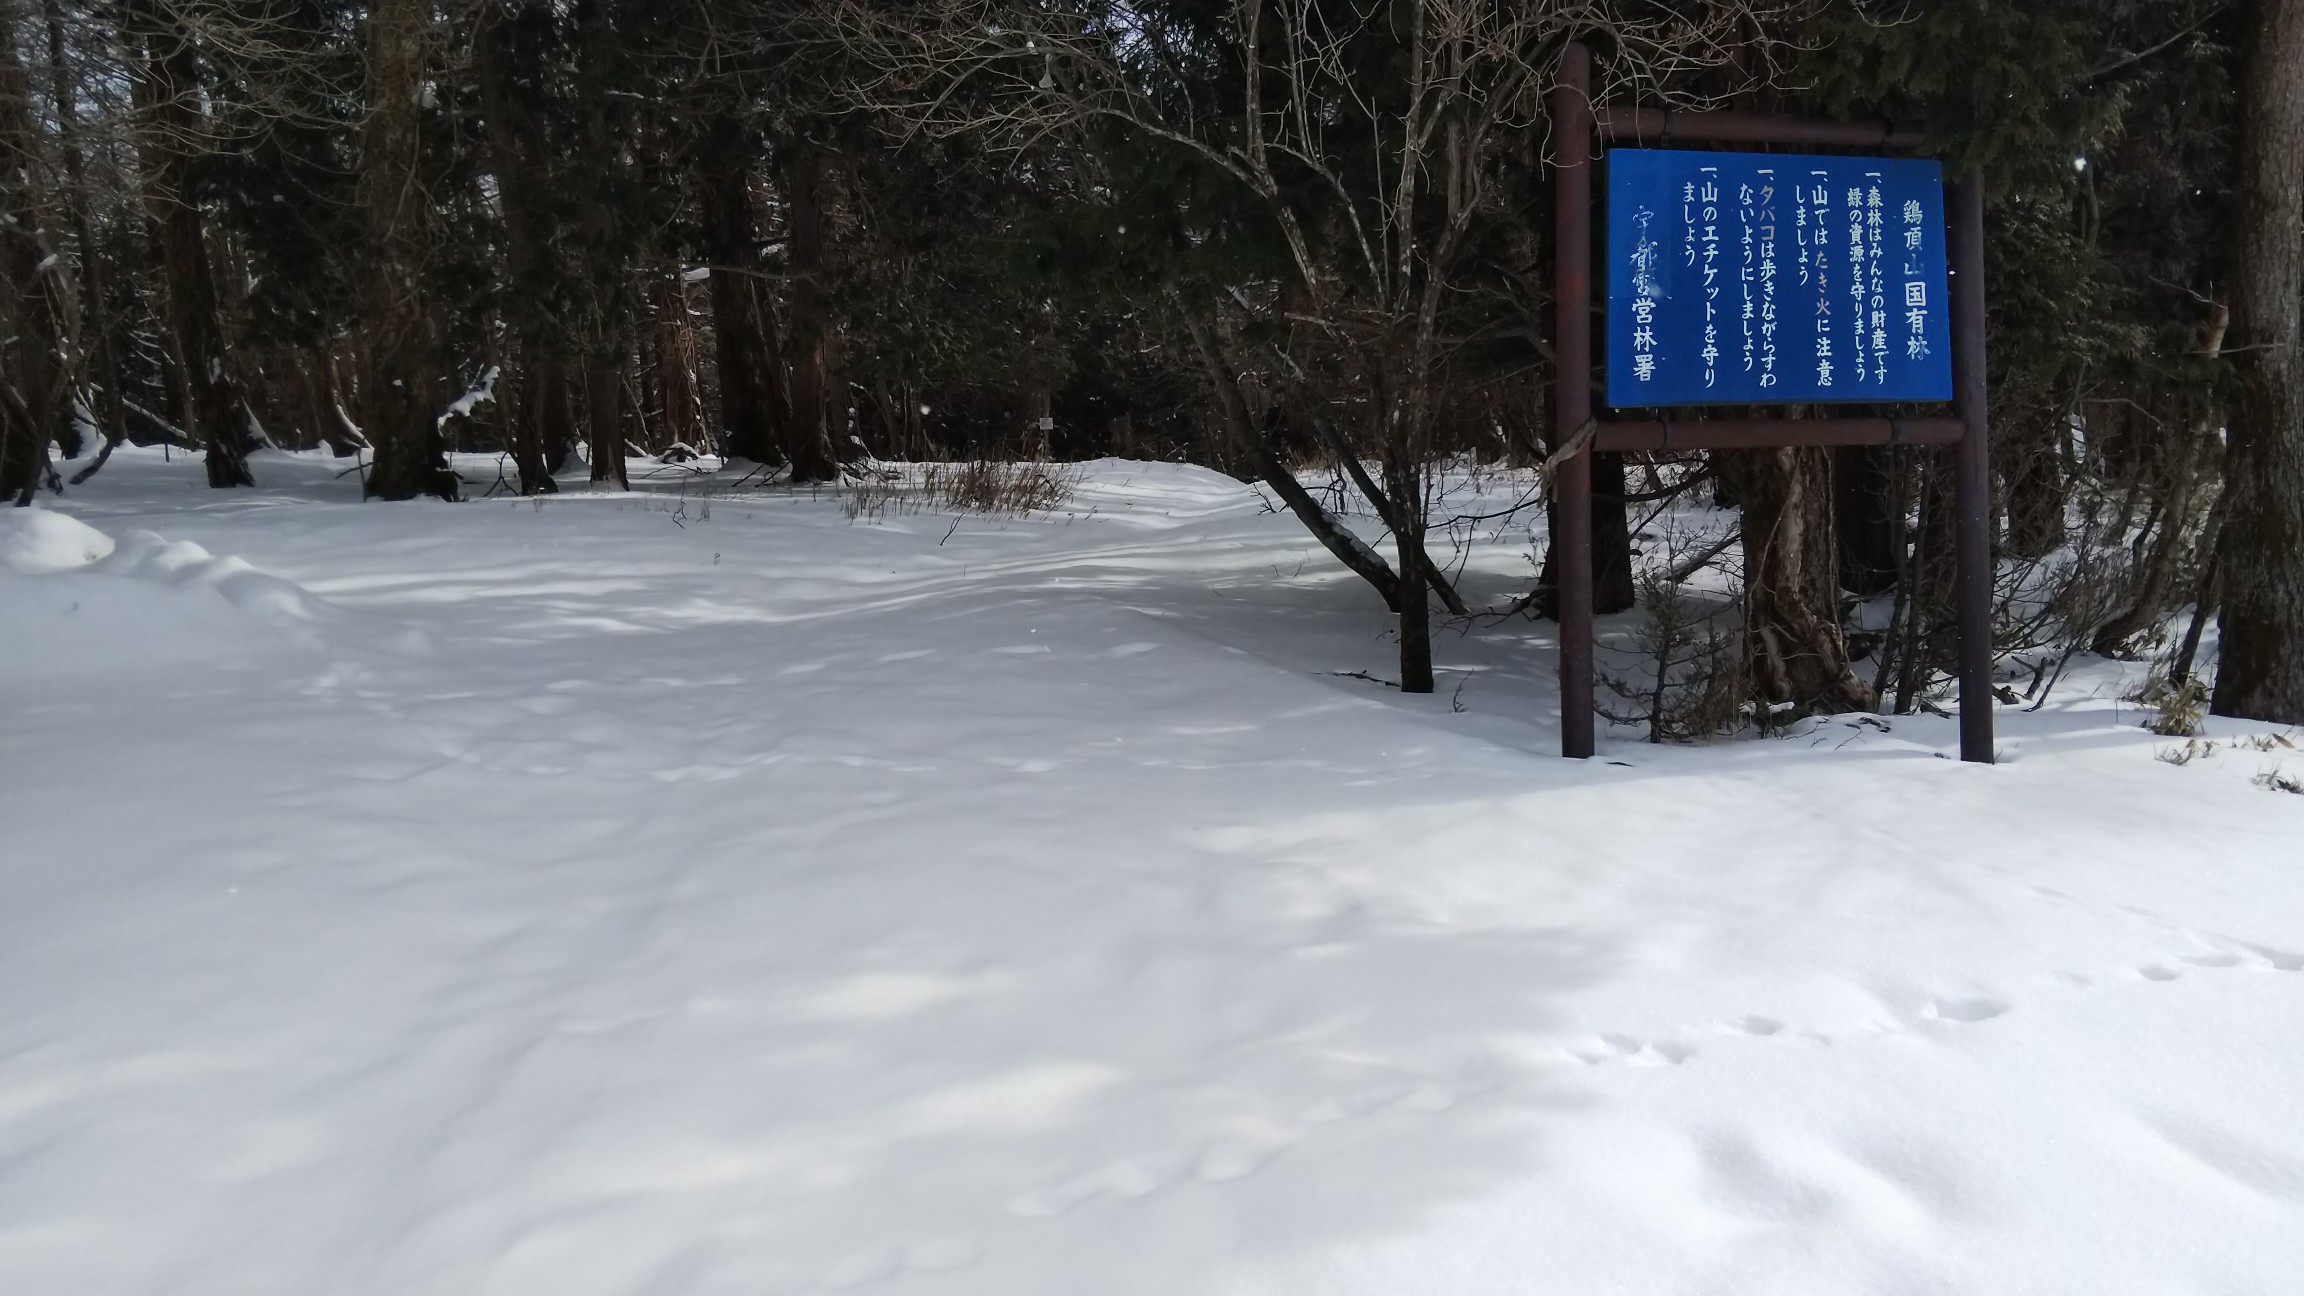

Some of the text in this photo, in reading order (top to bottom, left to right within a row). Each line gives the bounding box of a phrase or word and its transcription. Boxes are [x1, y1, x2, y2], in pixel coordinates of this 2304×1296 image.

[1682, 183, 1697, 268] ましょう
[1738, 184, 1756, 372] ないようにしましょう
[1794, 185, 1809, 287] しましょう
[1847, 188, 1867, 383] 緑の資源を守りましょう
